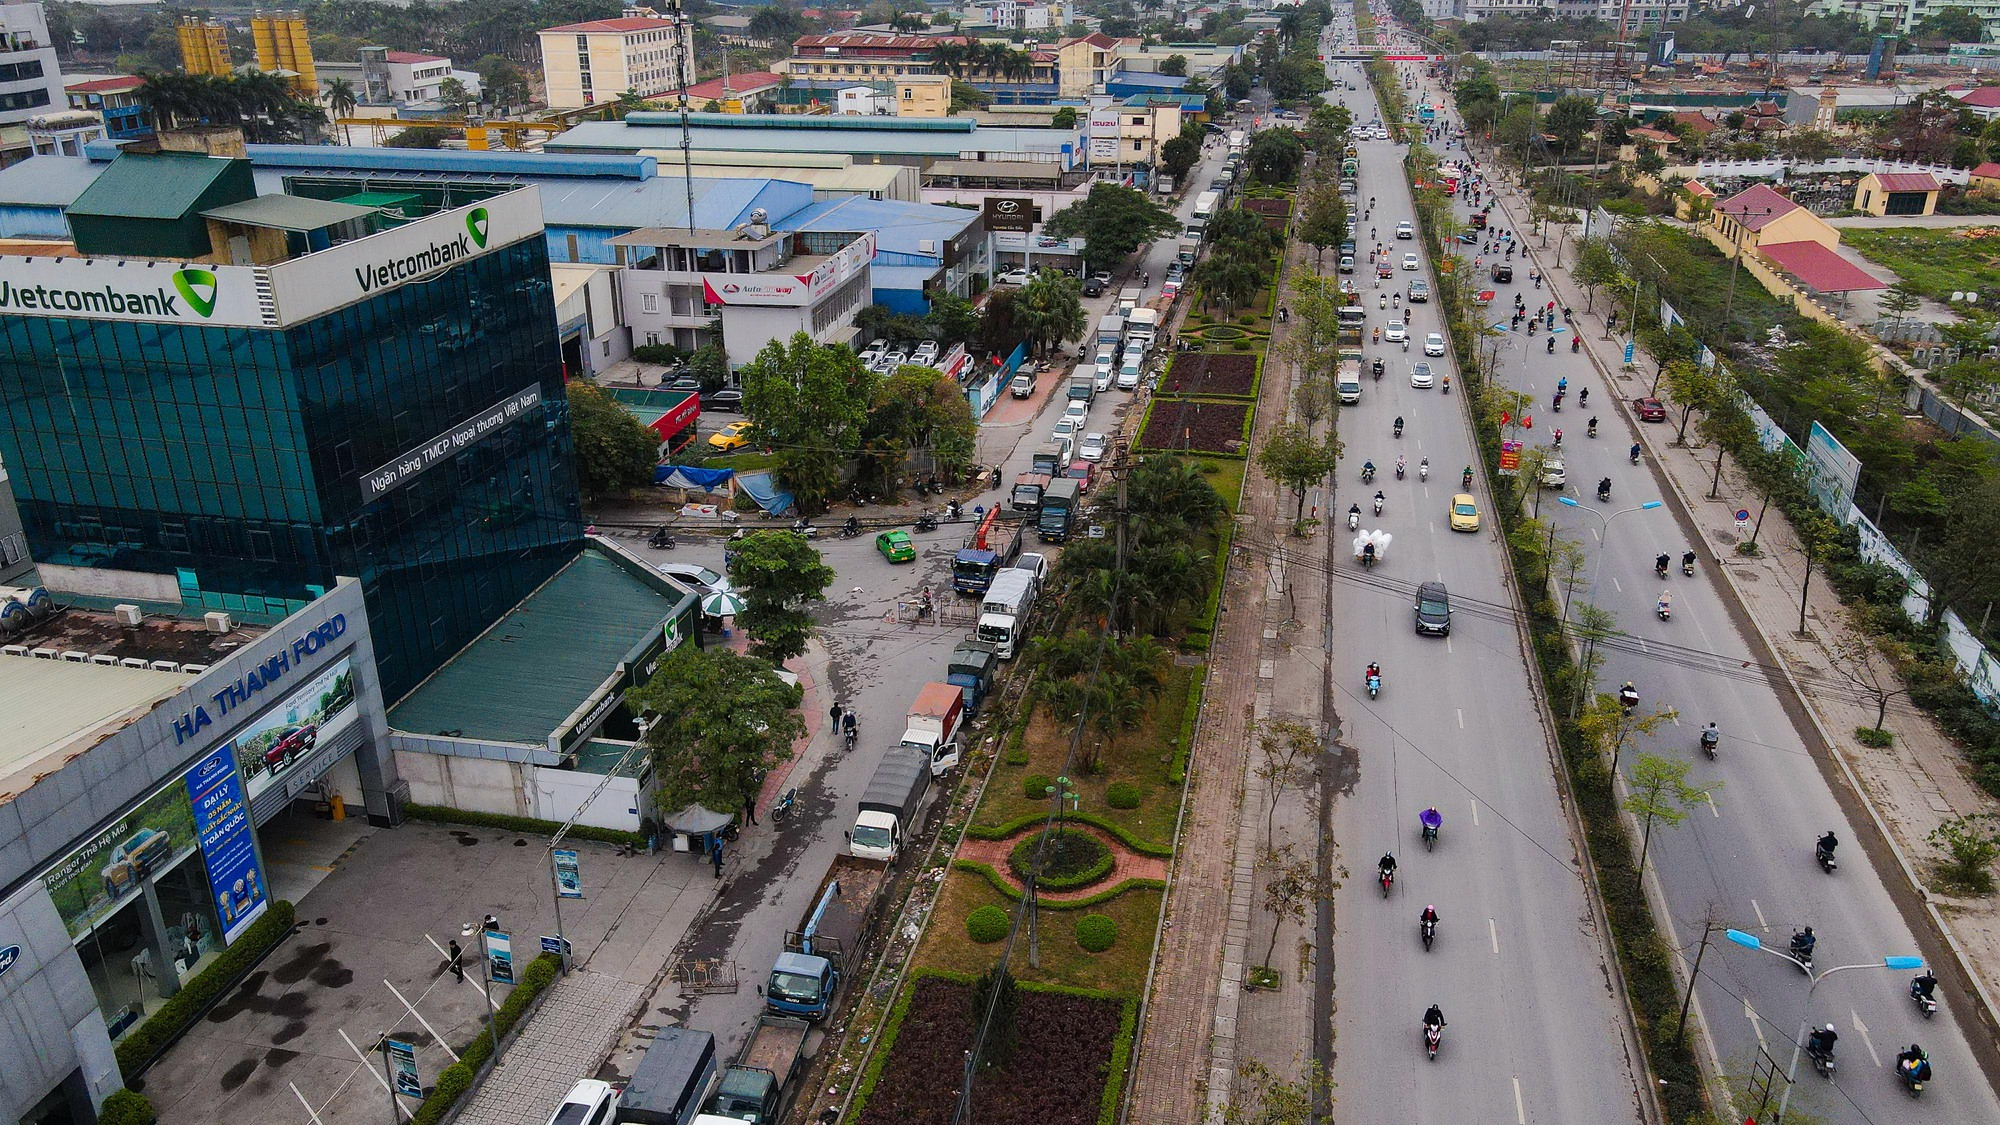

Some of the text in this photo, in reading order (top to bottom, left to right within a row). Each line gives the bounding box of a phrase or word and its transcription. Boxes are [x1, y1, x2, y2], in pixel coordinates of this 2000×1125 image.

[355, 233, 471, 293] Vietcombank
[371, 473, 396, 493] Ngân
[399, 457, 421, 477] hàng
[422, 439, 450, 463] TMCP
[452, 425, 476, 446] Ngoại
[504, 401, 519, 418] Việt
[520, 393, 537, 408] Nam
[172, 706, 212, 745] HA
[212, 650, 290, 715] THANH
[291, 613, 346, 665] FORD
[575, 691, 615, 735] Vietcombank
[203, 773, 217, 785] THANH
[217, 764, 229, 774] FORD
[294, 754, 333, 789] SERVICE
[204, 784, 229, 808] ĐẠI LÝ
[208, 798, 232, 819] 05 NĂM
[202, 821, 217, 836] XUẤT
[204, 812, 244, 847] TOÀN QUỐC
[48, 858, 80, 885] Ranger
[80, 843, 98, 860] Thế
[99, 834, 111, 848] Hệ
[112, 822, 128, 838] Mới
[80, 860, 93, 872] gian
